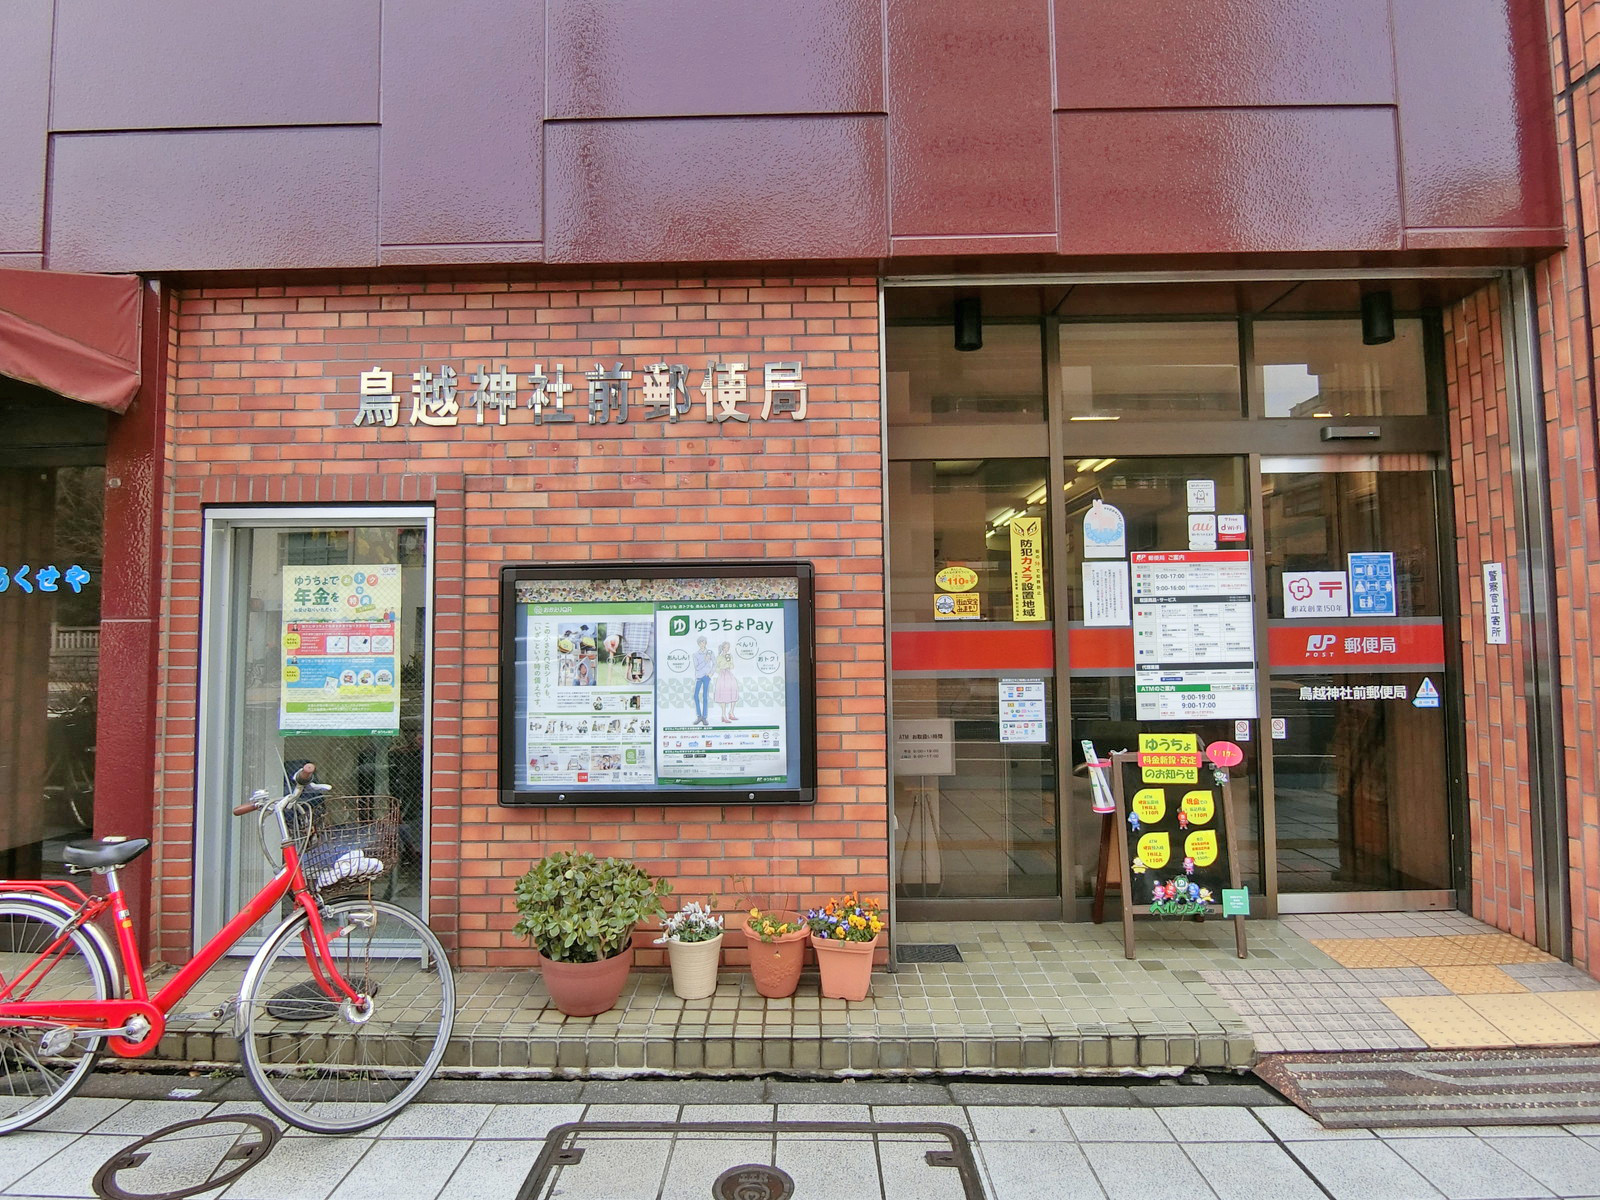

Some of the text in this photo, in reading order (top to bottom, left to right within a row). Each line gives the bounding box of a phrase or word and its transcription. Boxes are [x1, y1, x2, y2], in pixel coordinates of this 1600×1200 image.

[353, 360, 808, 427] 鳥越神社前郵便局
[1192, 523, 1213, 532] au
[294, 576, 340, 587] ゆうちょで
[1020, 540, 1036, 617] 防犯カメラ設置地域
[294, 587, 340, 606] 年金を
[1488, 570, 1502, 637] 警察官立寄所
[1291, 604, 1343, 613] 郵政創業150年
[694, 618, 774, 634] ゆうちょPay
[1344, 637, 1396, 654] 郵便局
[1299, 685, 1407, 700] 鳥越神社前郵便局
[1145, 738, 1192, 751] ゆうちょ
[1142, 755, 1197, 765] 料金新設・改定
[1144, 769, 1195, 780] のお知らせ
